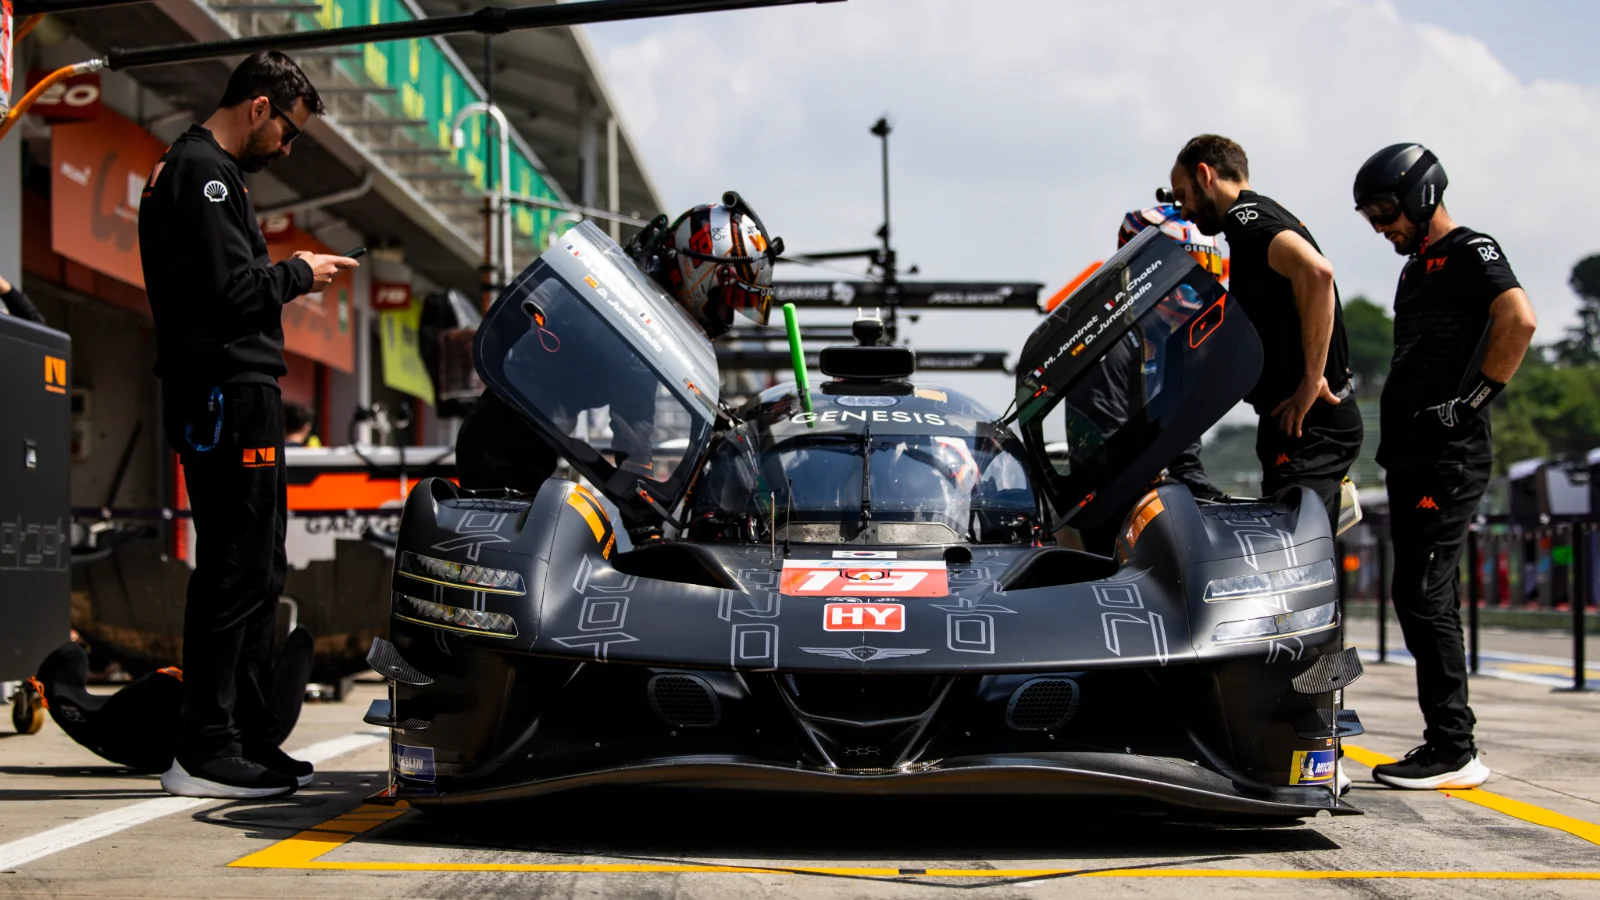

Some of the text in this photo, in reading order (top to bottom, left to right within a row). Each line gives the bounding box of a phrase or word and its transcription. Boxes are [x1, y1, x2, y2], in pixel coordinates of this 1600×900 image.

[1126, 259, 1163, 292] Chatin
[791, 410, 946, 426] GENESIS
[798, 570, 929, 592] 19
[831, 607, 898, 625] HY
